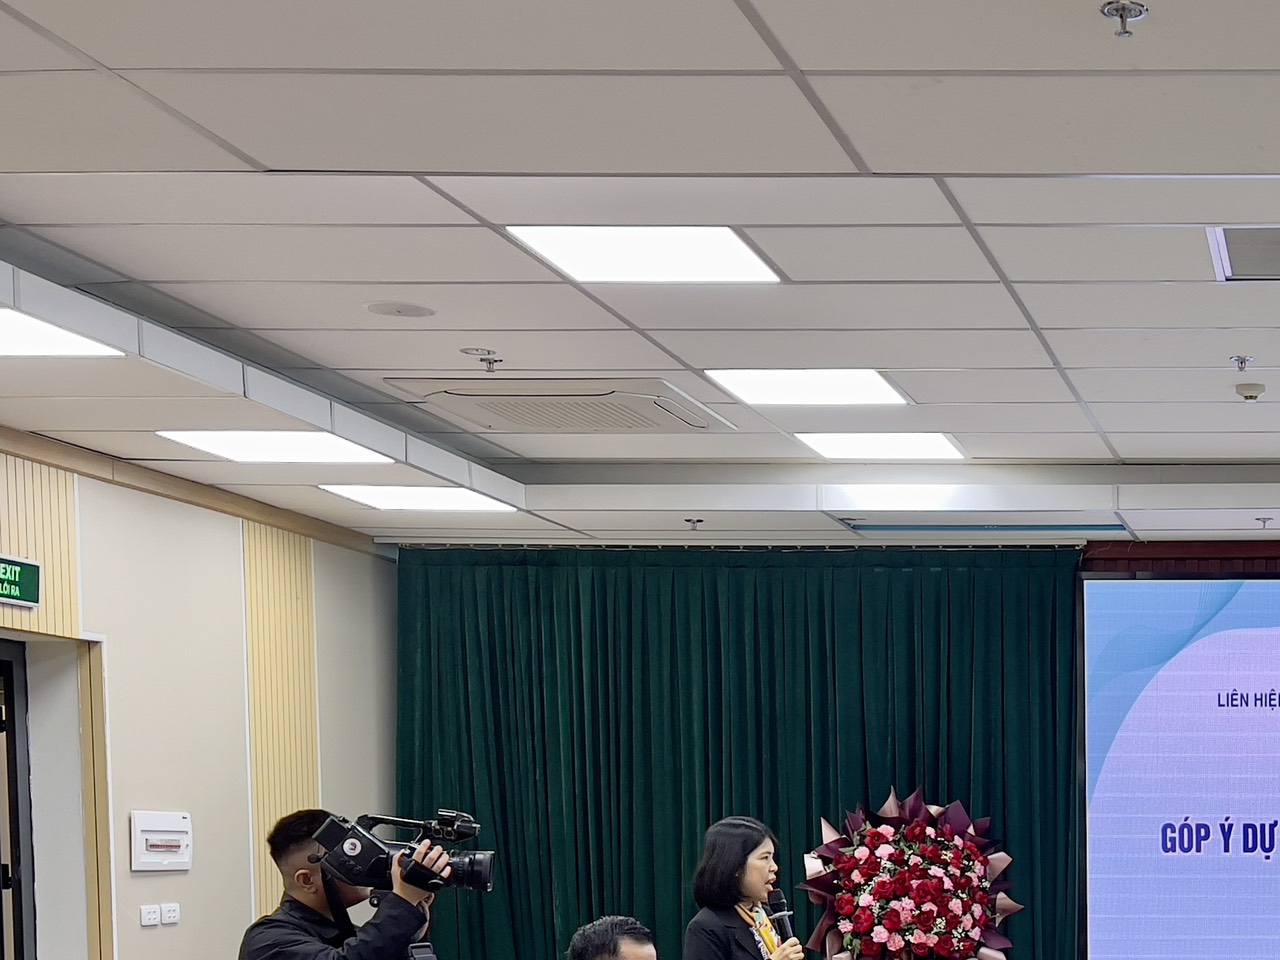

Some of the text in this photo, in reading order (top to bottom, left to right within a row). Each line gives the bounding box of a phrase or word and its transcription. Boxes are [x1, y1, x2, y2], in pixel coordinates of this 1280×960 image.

[0, 563, 21, 582] EXIT
[11, 584, 20, 597] RA
[1217, 688, 1249, 707] LIÊN
[1161, 816, 1211, 853] GÓP
[1219, 816, 1234, 853] Ý
[1242, 820, 1279, 860] DỰ
